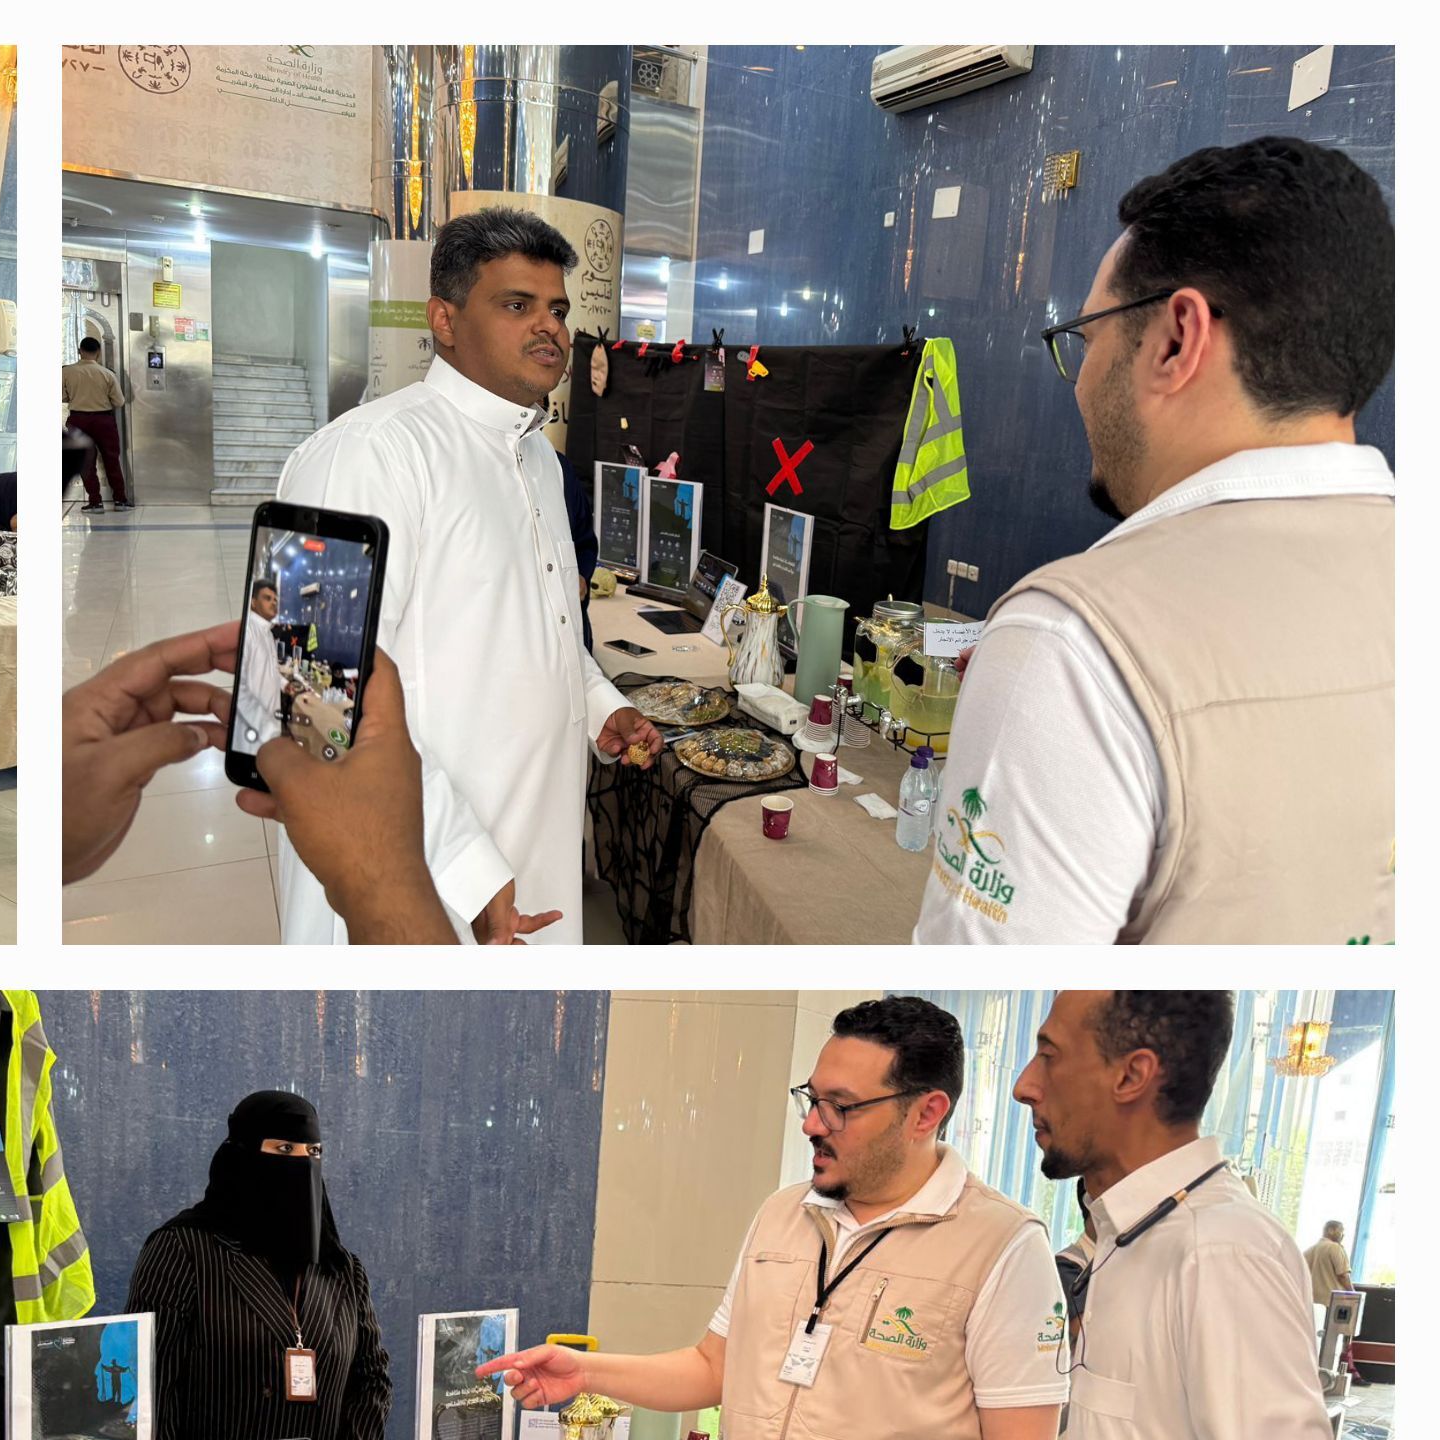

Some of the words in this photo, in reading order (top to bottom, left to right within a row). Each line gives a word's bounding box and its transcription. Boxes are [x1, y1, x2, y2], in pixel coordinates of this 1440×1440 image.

[266, 54, 300, 69] الصحة
[302, 62, 323, 75] وزارة
[969, 860, 1015, 905] وزارة
[868, 1328, 904, 1344] الصحة
[905, 1334, 928, 1351] وزارة
